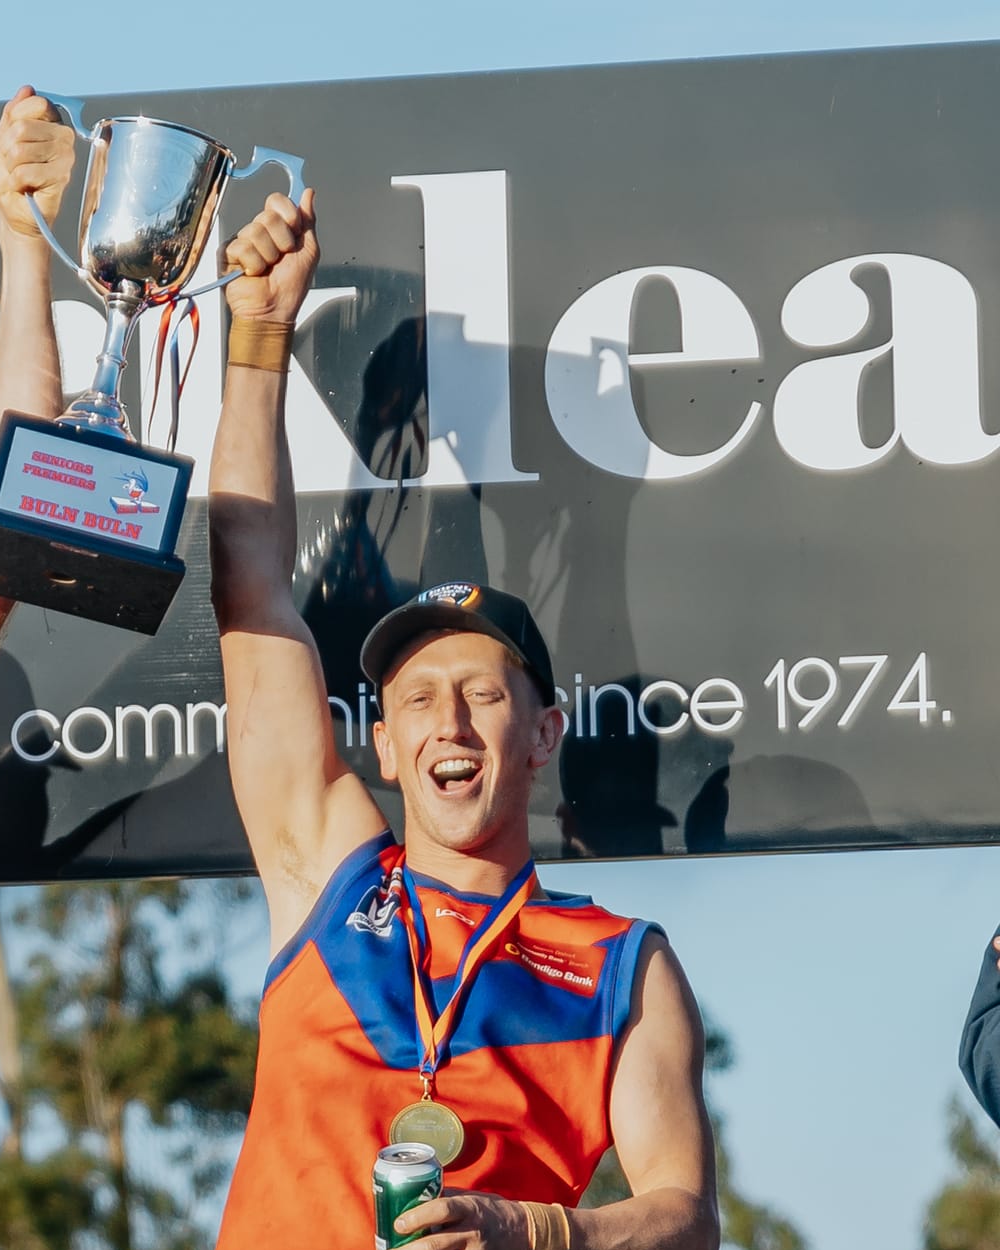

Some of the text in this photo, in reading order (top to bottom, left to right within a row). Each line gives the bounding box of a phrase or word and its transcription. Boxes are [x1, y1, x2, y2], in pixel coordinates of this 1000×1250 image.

[22, 462, 96, 491] PREMIERS
[31, 450, 94, 475] SENIORS
[19, 494, 144, 540] BULN BULN
[763, 652, 955, 730] 1974.
[521, 953, 594, 987] Bendigo Bank
